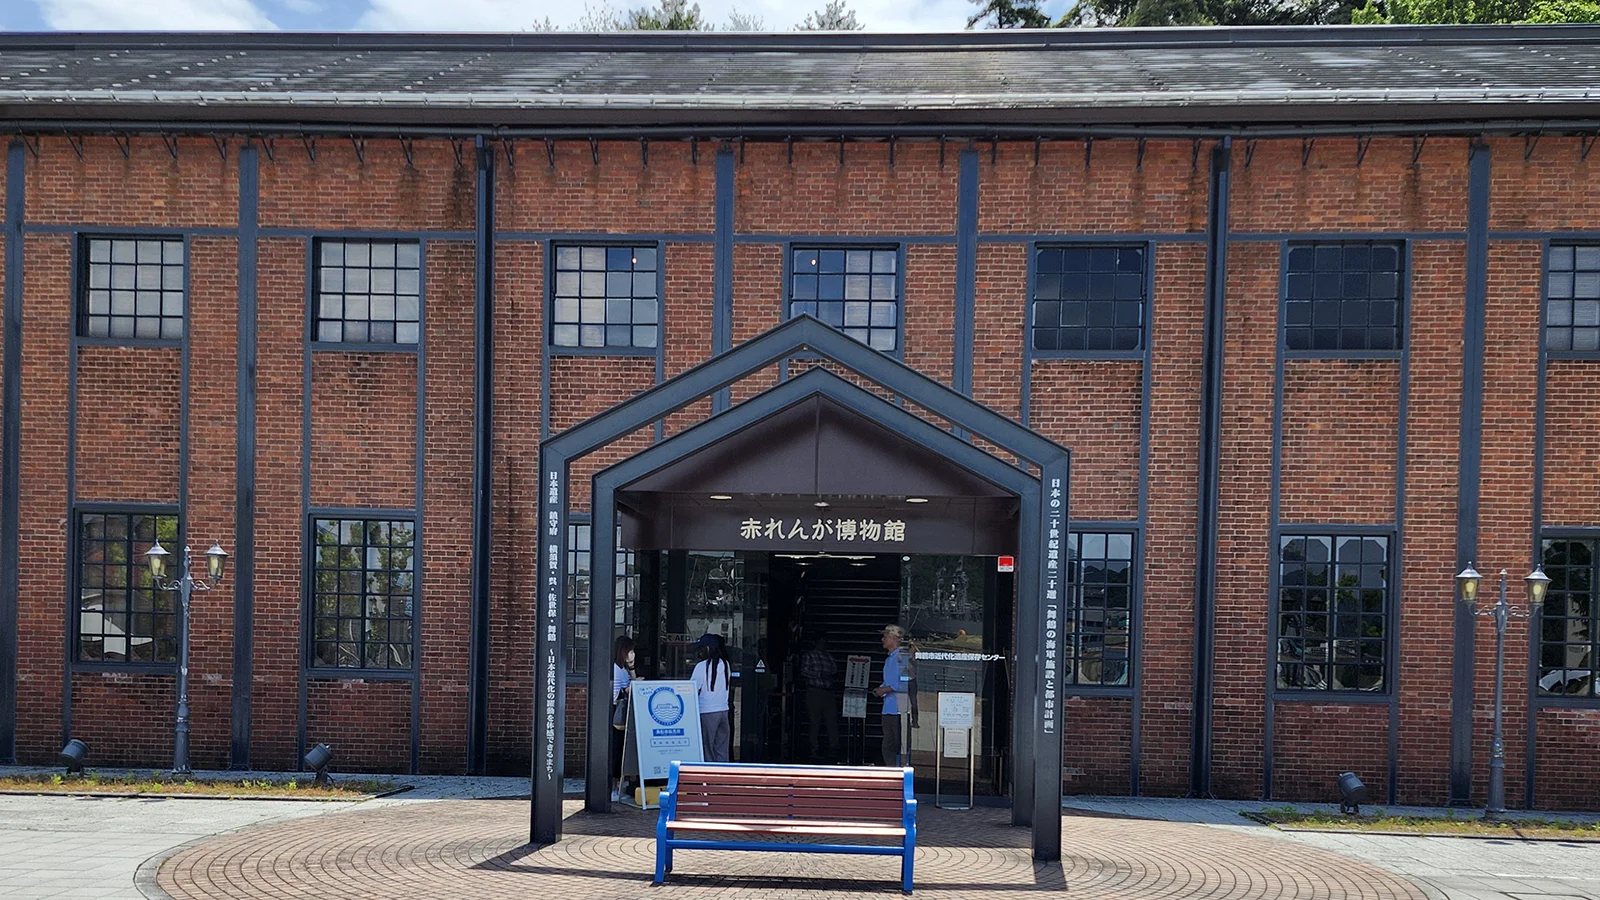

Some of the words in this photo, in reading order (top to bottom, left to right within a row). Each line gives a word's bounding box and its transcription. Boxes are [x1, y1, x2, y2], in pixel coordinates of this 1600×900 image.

[740, 517, 906, 542] 赤れんが博物館
